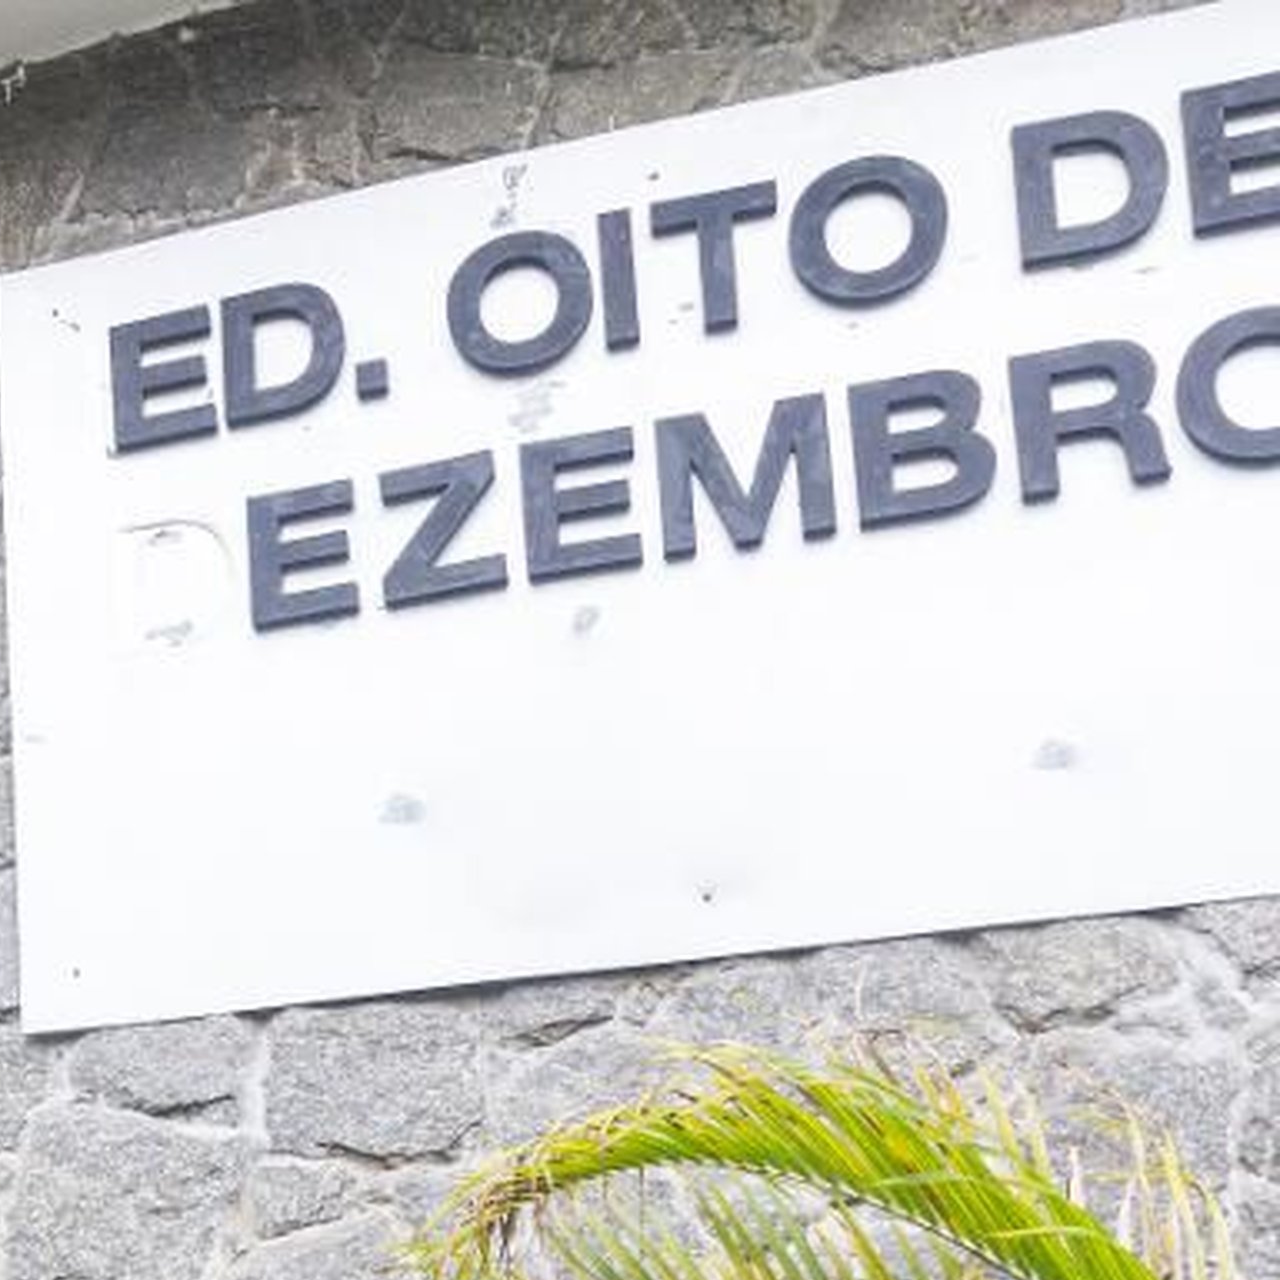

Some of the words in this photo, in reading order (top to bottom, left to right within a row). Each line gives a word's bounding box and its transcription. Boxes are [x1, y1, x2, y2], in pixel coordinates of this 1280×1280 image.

[110, 284, 388, 456] ED.
[447, 156, 947, 380] OITO
[1012, 72, 1280, 273] DE
